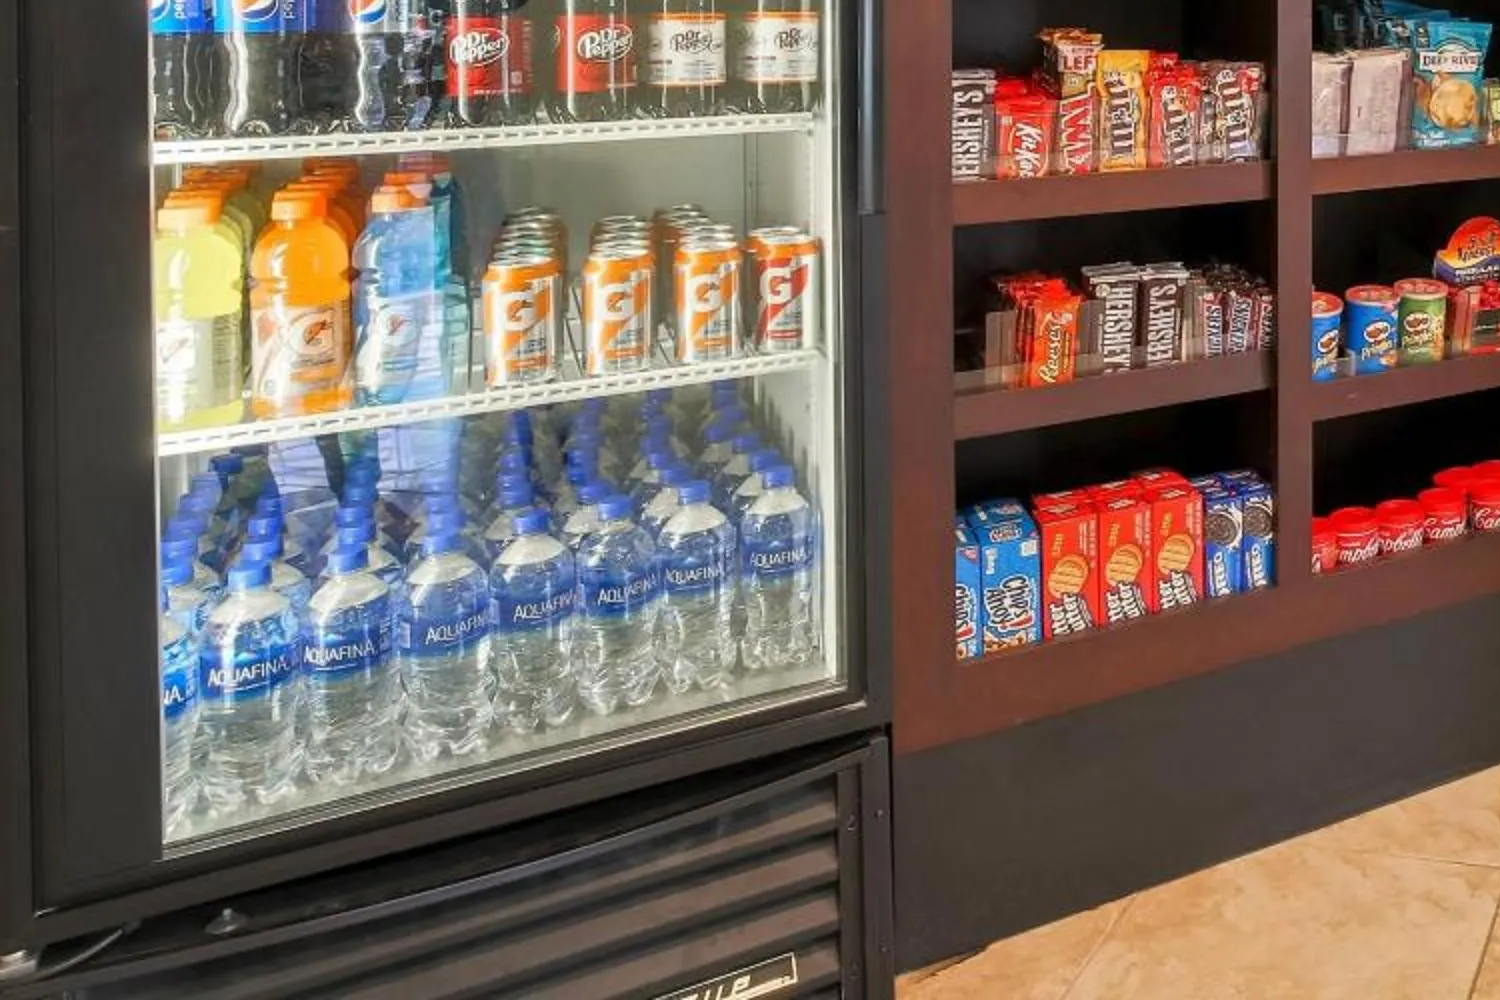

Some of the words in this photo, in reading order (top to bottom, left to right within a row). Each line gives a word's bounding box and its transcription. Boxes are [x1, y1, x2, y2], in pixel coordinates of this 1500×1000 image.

[578, 34, 634, 62] Pepper
[599, 28, 621, 43] Dr
[1062, 54, 1094, 73] LEF
[951, 90, 985, 183] ERSHEY'S
[1147, 283, 1178, 369] ERSHEY'S
[664, 560, 726, 585] AQUAFINA
[1170, 569, 1193, 605] utter
[513, 589, 583, 623] AQUAFINA
[597, 573, 659, 606] AQUAFINA
[1001, 575, 1030, 619] Chips
[1118, 581, 1141, 618] utter
[1159, 579, 1175, 609] tter
[1050, 602, 1070, 636] tter
[1063, 593, 1087, 632] utter
[1105, 591, 1124, 622] tter
[425, 611, 493, 645] AQUAFINA
[303, 638, 376, 666] AQUAFINA
[207, 656, 290, 688] AQUAFINA
